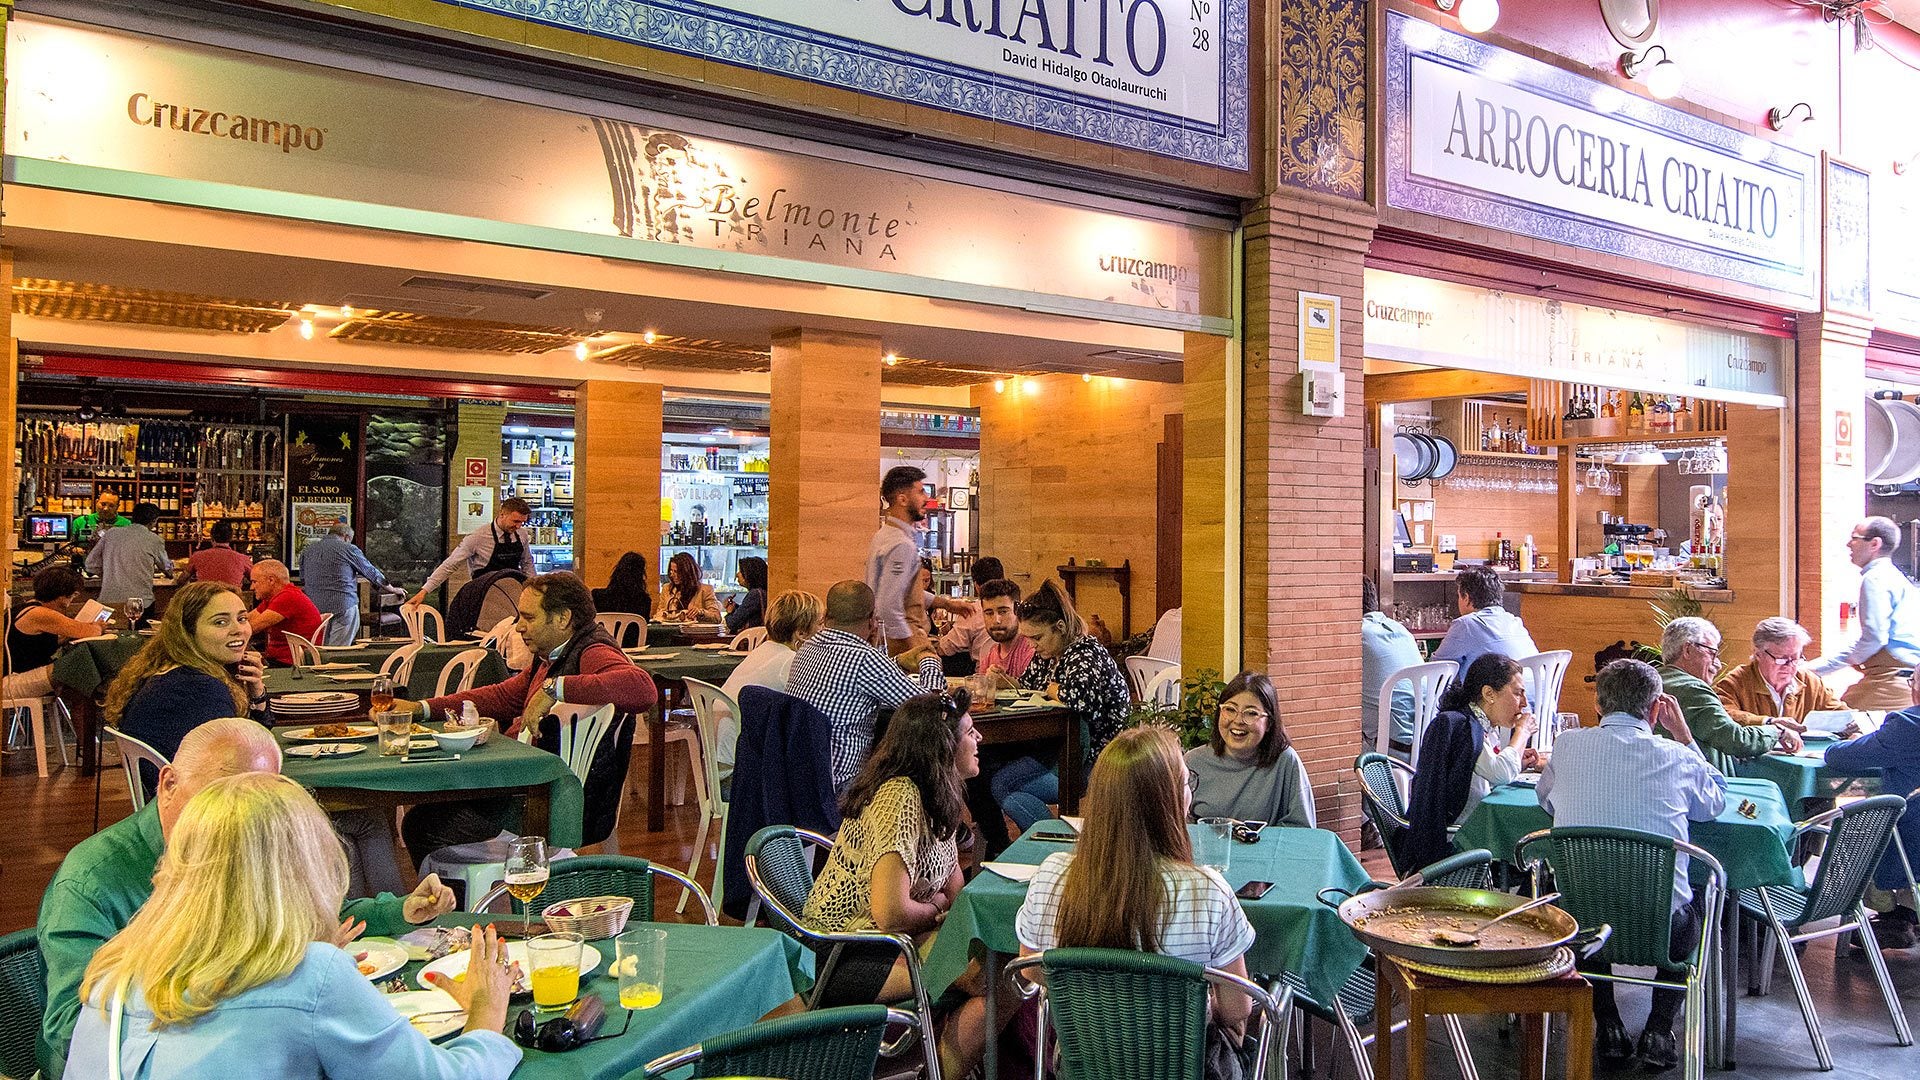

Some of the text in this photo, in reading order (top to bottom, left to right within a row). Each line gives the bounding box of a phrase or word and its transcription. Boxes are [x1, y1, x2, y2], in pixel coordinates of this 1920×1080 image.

[891, 0, 1167, 76] AITO
[1193, 27, 1209, 51] 28
[1002, 48, 1167, 101] David Hidalgo Otaolaurruchi
[127, 92, 324, 153] Cruzcampo
[1443, 90, 1653, 208] ARROCERIA
[1661, 157, 1777, 239] CRIAITO
[710, 184, 900, 238] Belmonte
[709, 218, 897, 261] TRIANA
[1099, 255, 1187, 285] Cruzcampo
[1366, 299, 1433, 329] Cruzcampo
[1570, 349, 1644, 371] TRIANA
[291, 496, 306, 504] DE
[298, 485, 311, 494] EL
